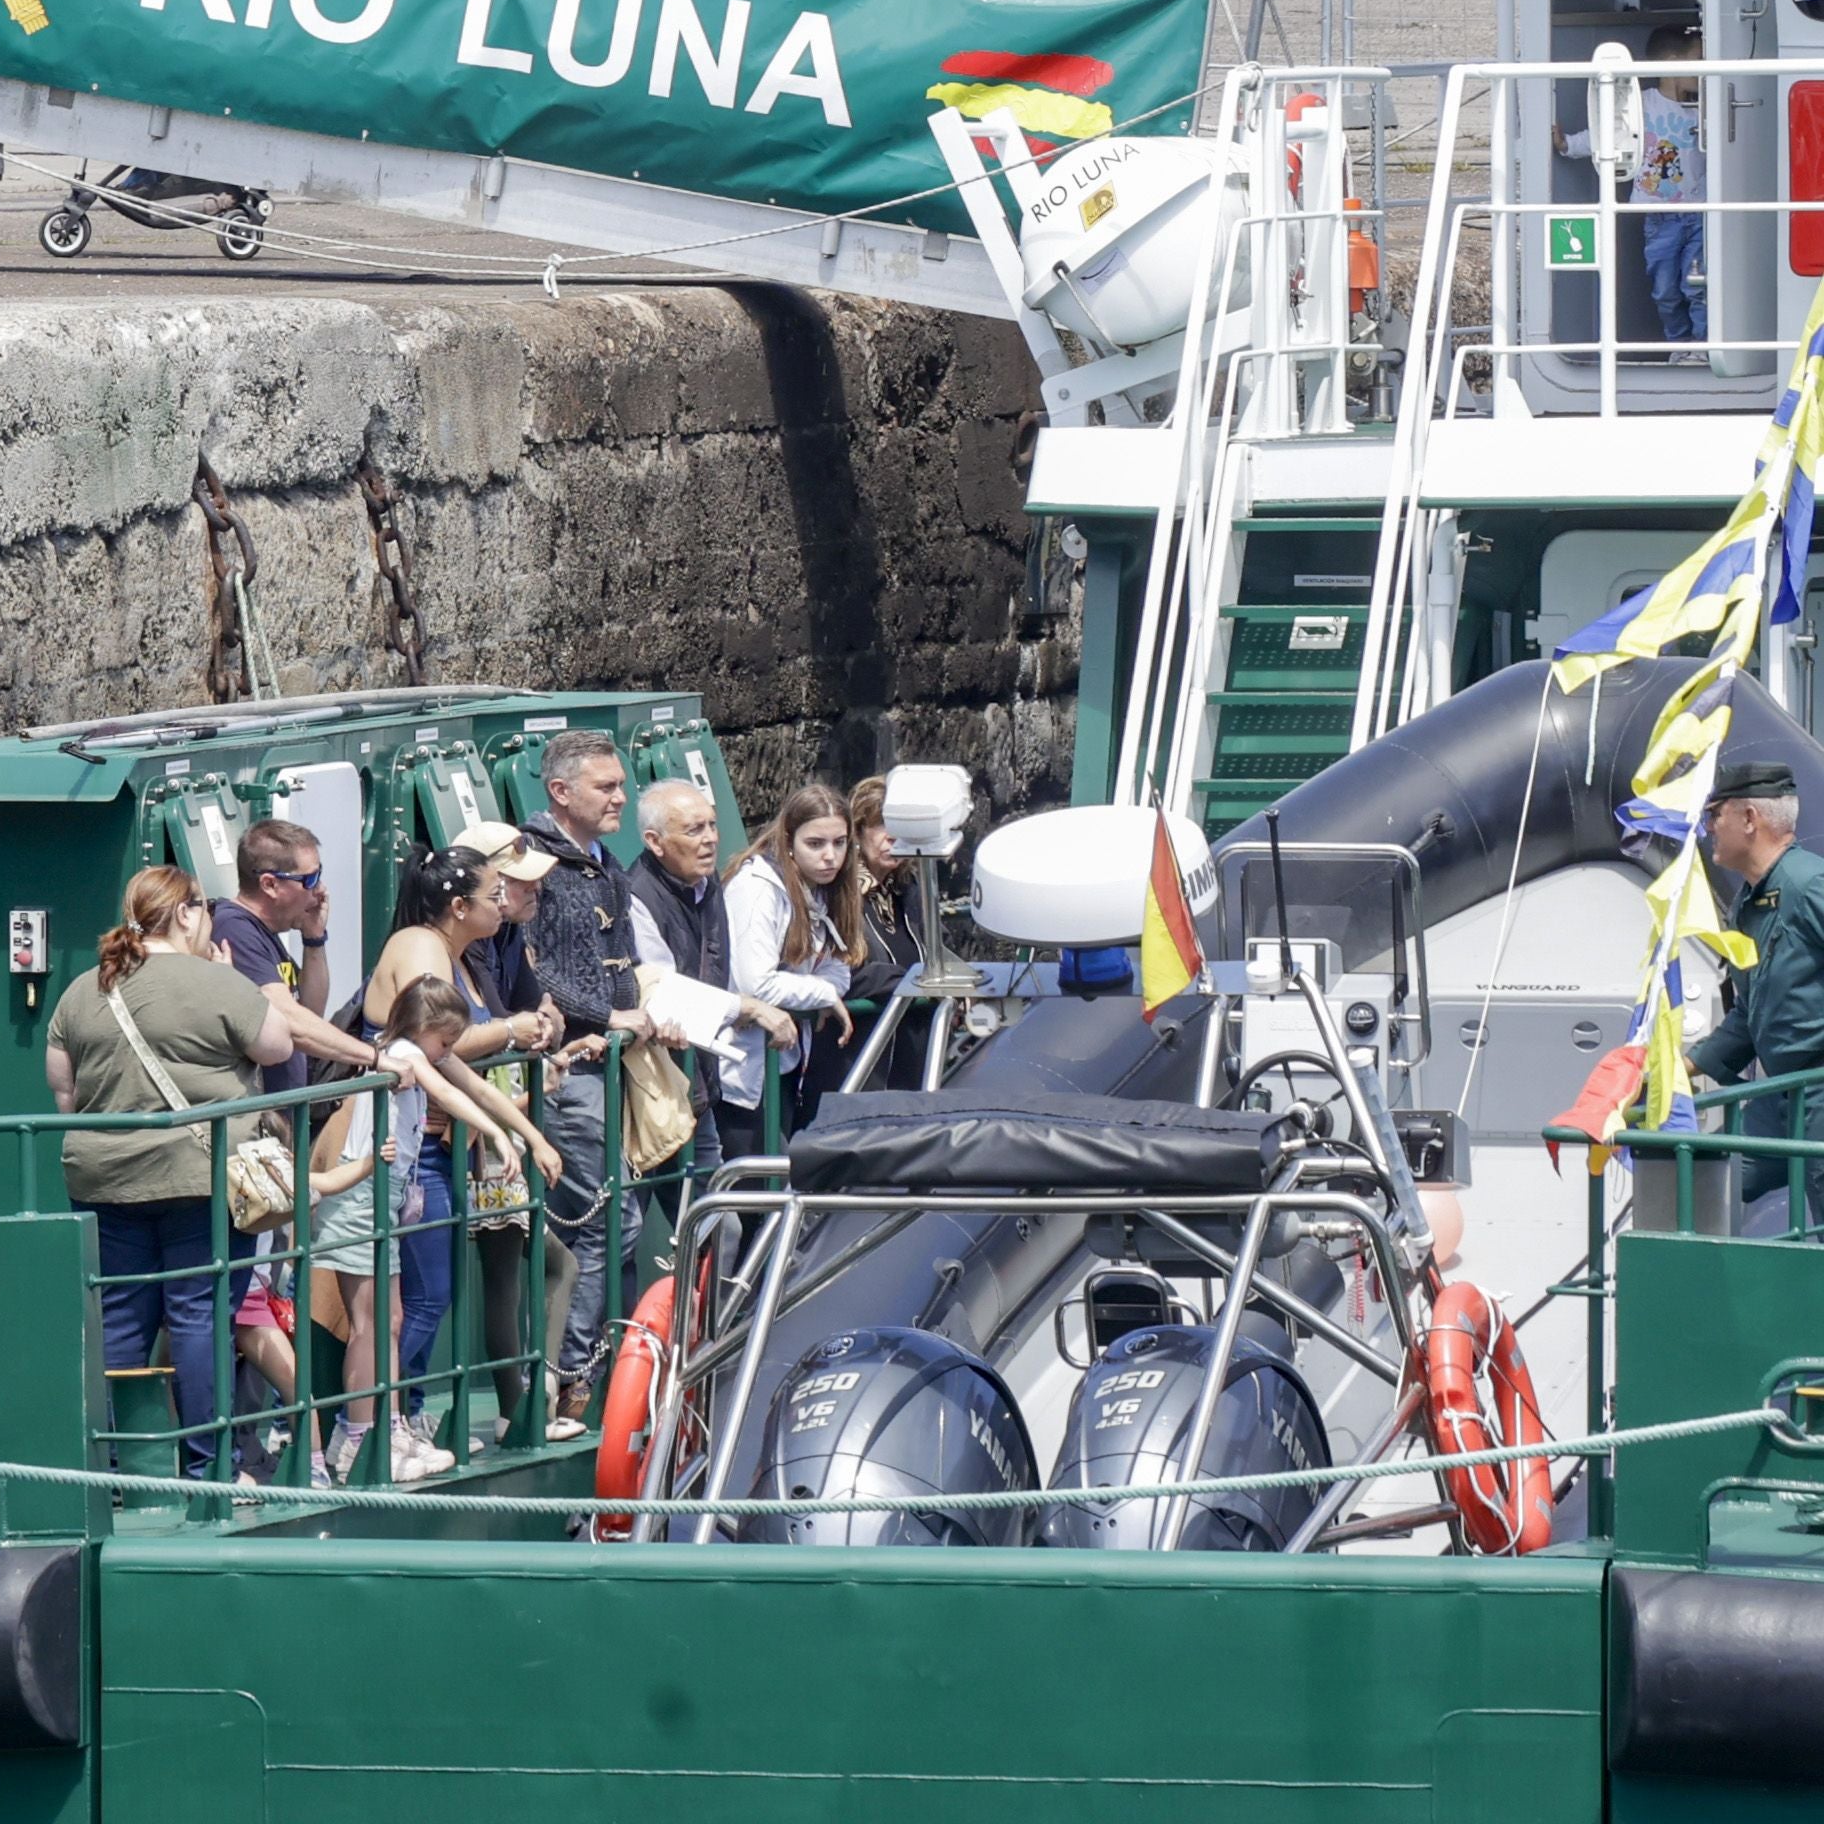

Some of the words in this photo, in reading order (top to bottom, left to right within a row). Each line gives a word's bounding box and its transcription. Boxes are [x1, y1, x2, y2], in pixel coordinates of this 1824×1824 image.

[1030, 185, 1068, 224] RIO
[1071, 142, 1141, 190] LUNA
[1475, 983, 1581, 992] VANGUARD
[790, 1371, 861, 1405] 250
[1093, 1369, 1166, 1400] 250
[796, 1399, 838, 1422] V6
[1101, 1397, 1143, 1418] V6
[790, 1416, 830, 1434] 4.2L
[1094, 1415, 1135, 1430] 4.2L
